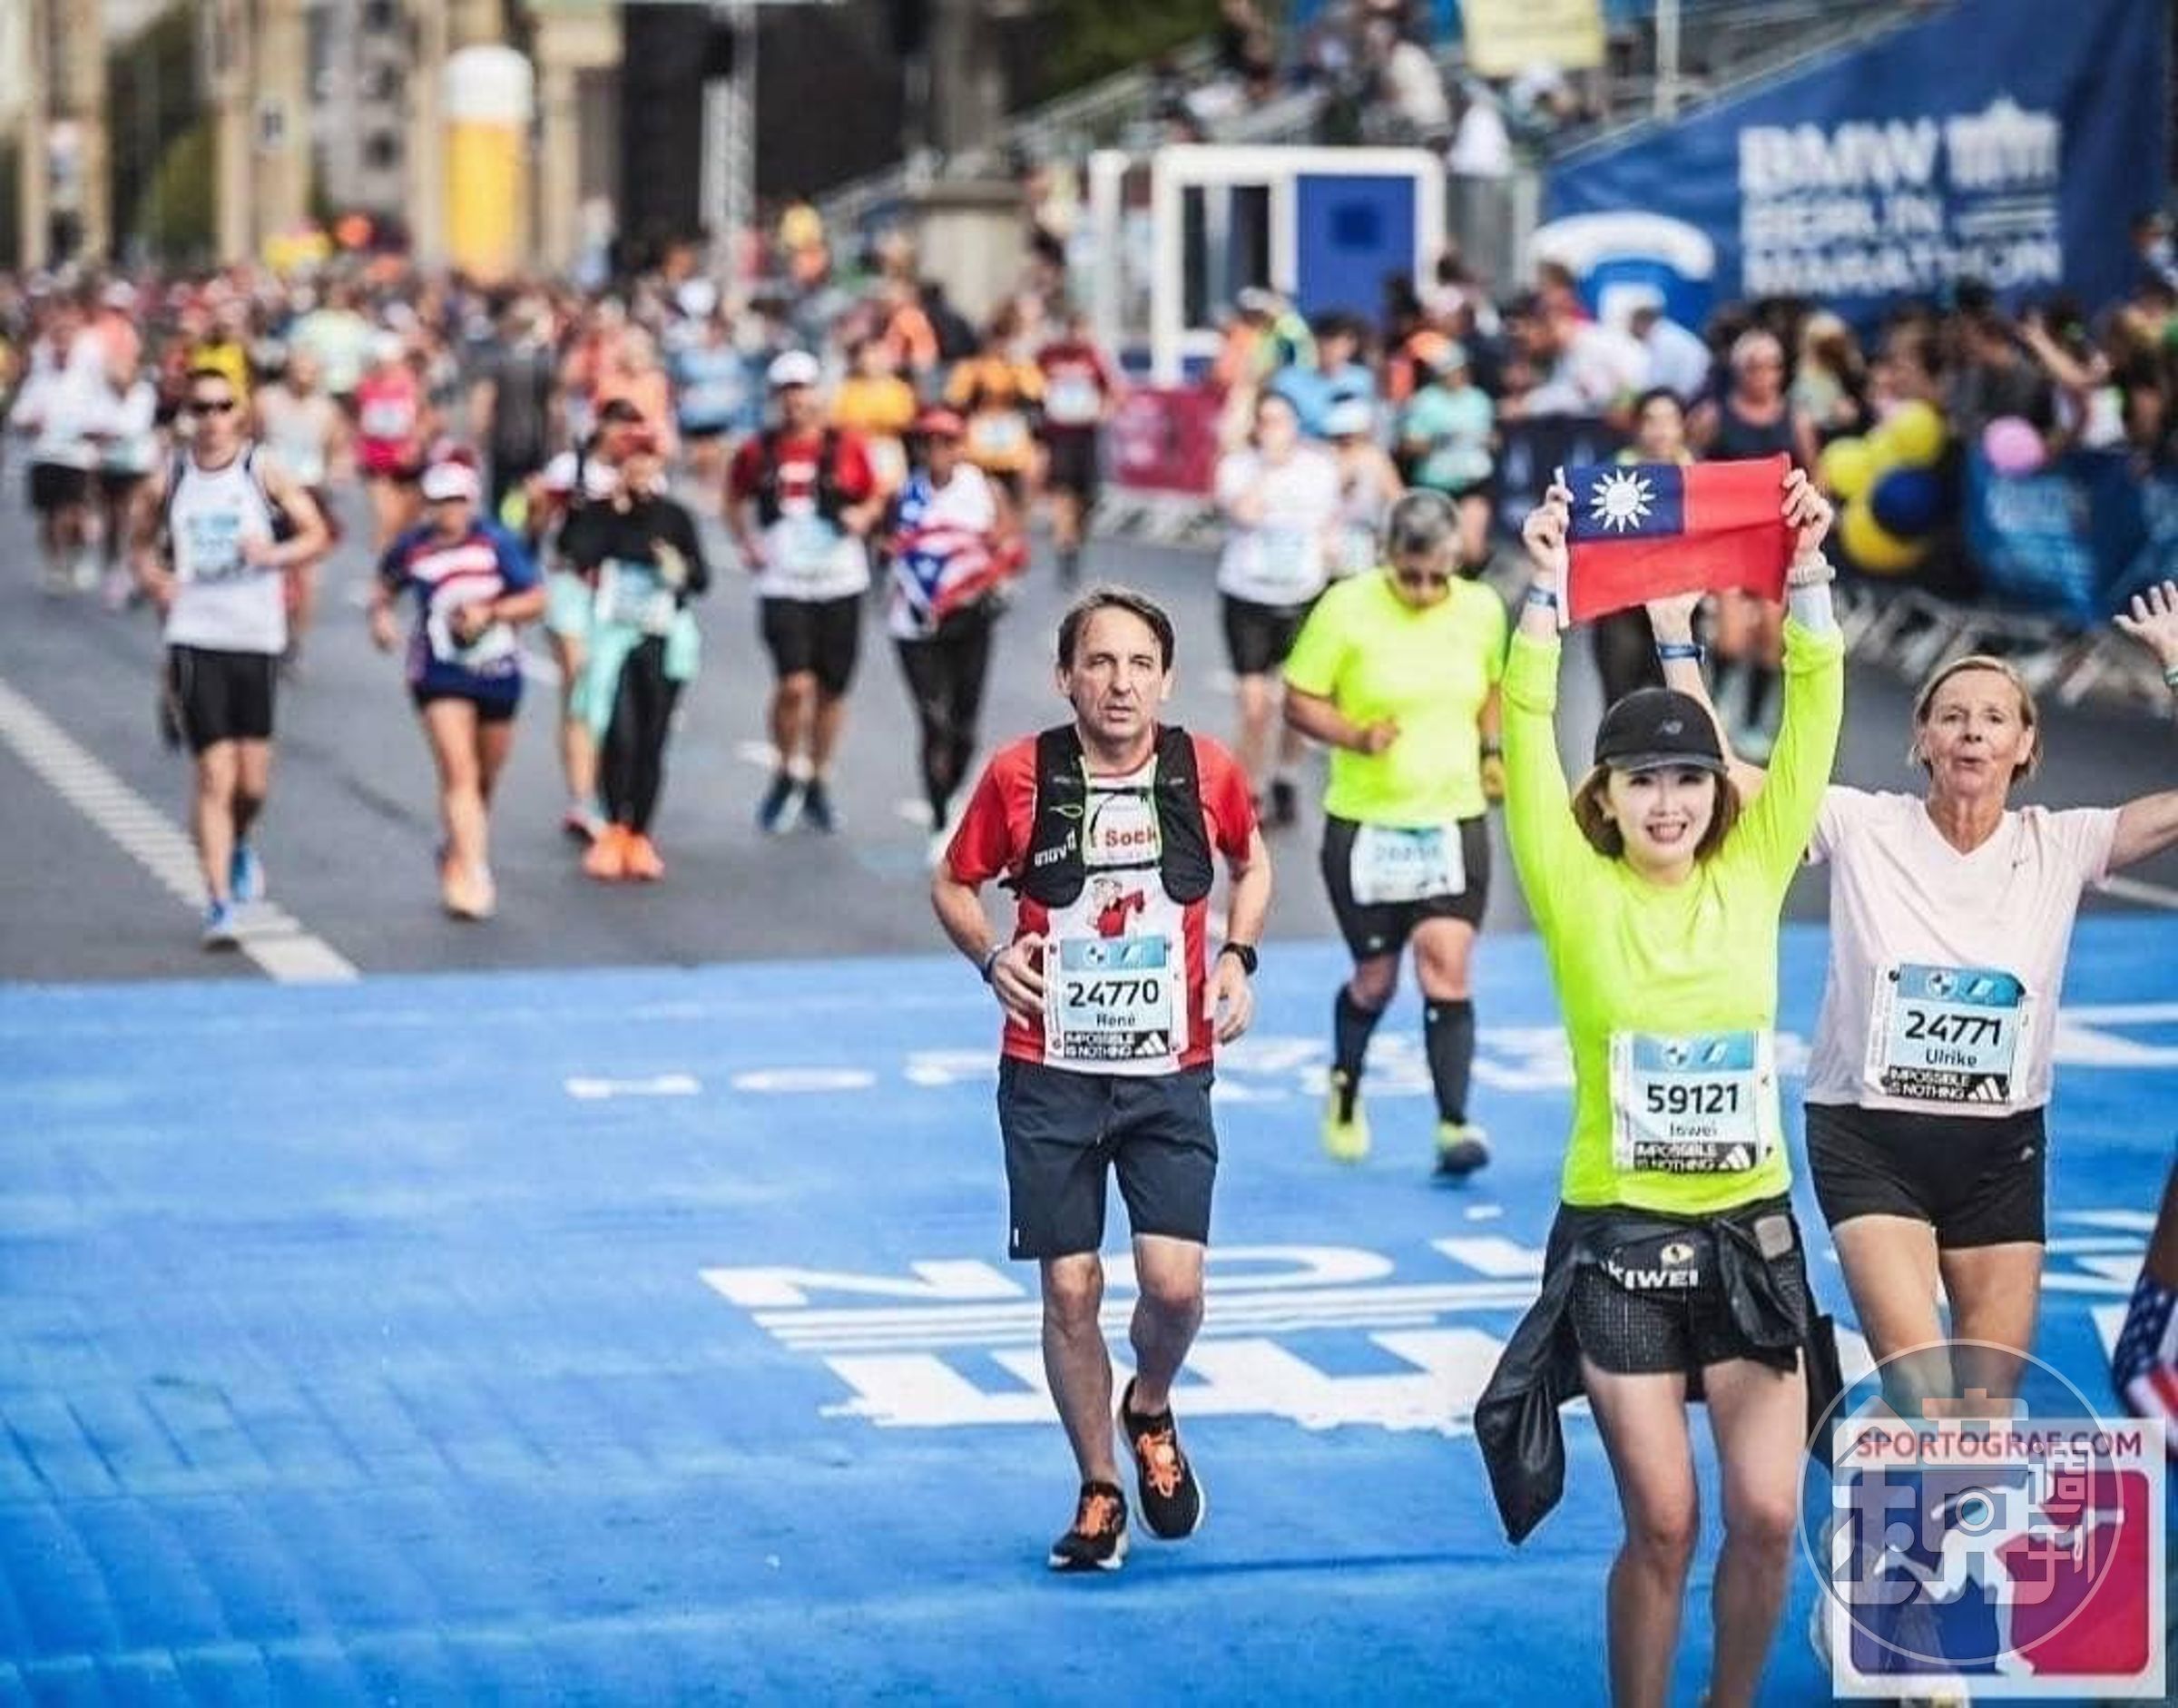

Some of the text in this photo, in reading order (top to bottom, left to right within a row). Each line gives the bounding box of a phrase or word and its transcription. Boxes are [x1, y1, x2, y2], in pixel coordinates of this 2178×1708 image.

[1066, 977, 1160, 1008] 24770
[1905, 1009, 2002, 1046] 24771
[1925, 1048, 1977, 1067] Ulrike
[1646, 1082, 1740, 1115] 59121
[1902, 1085, 1966, 1100] NOTHING
